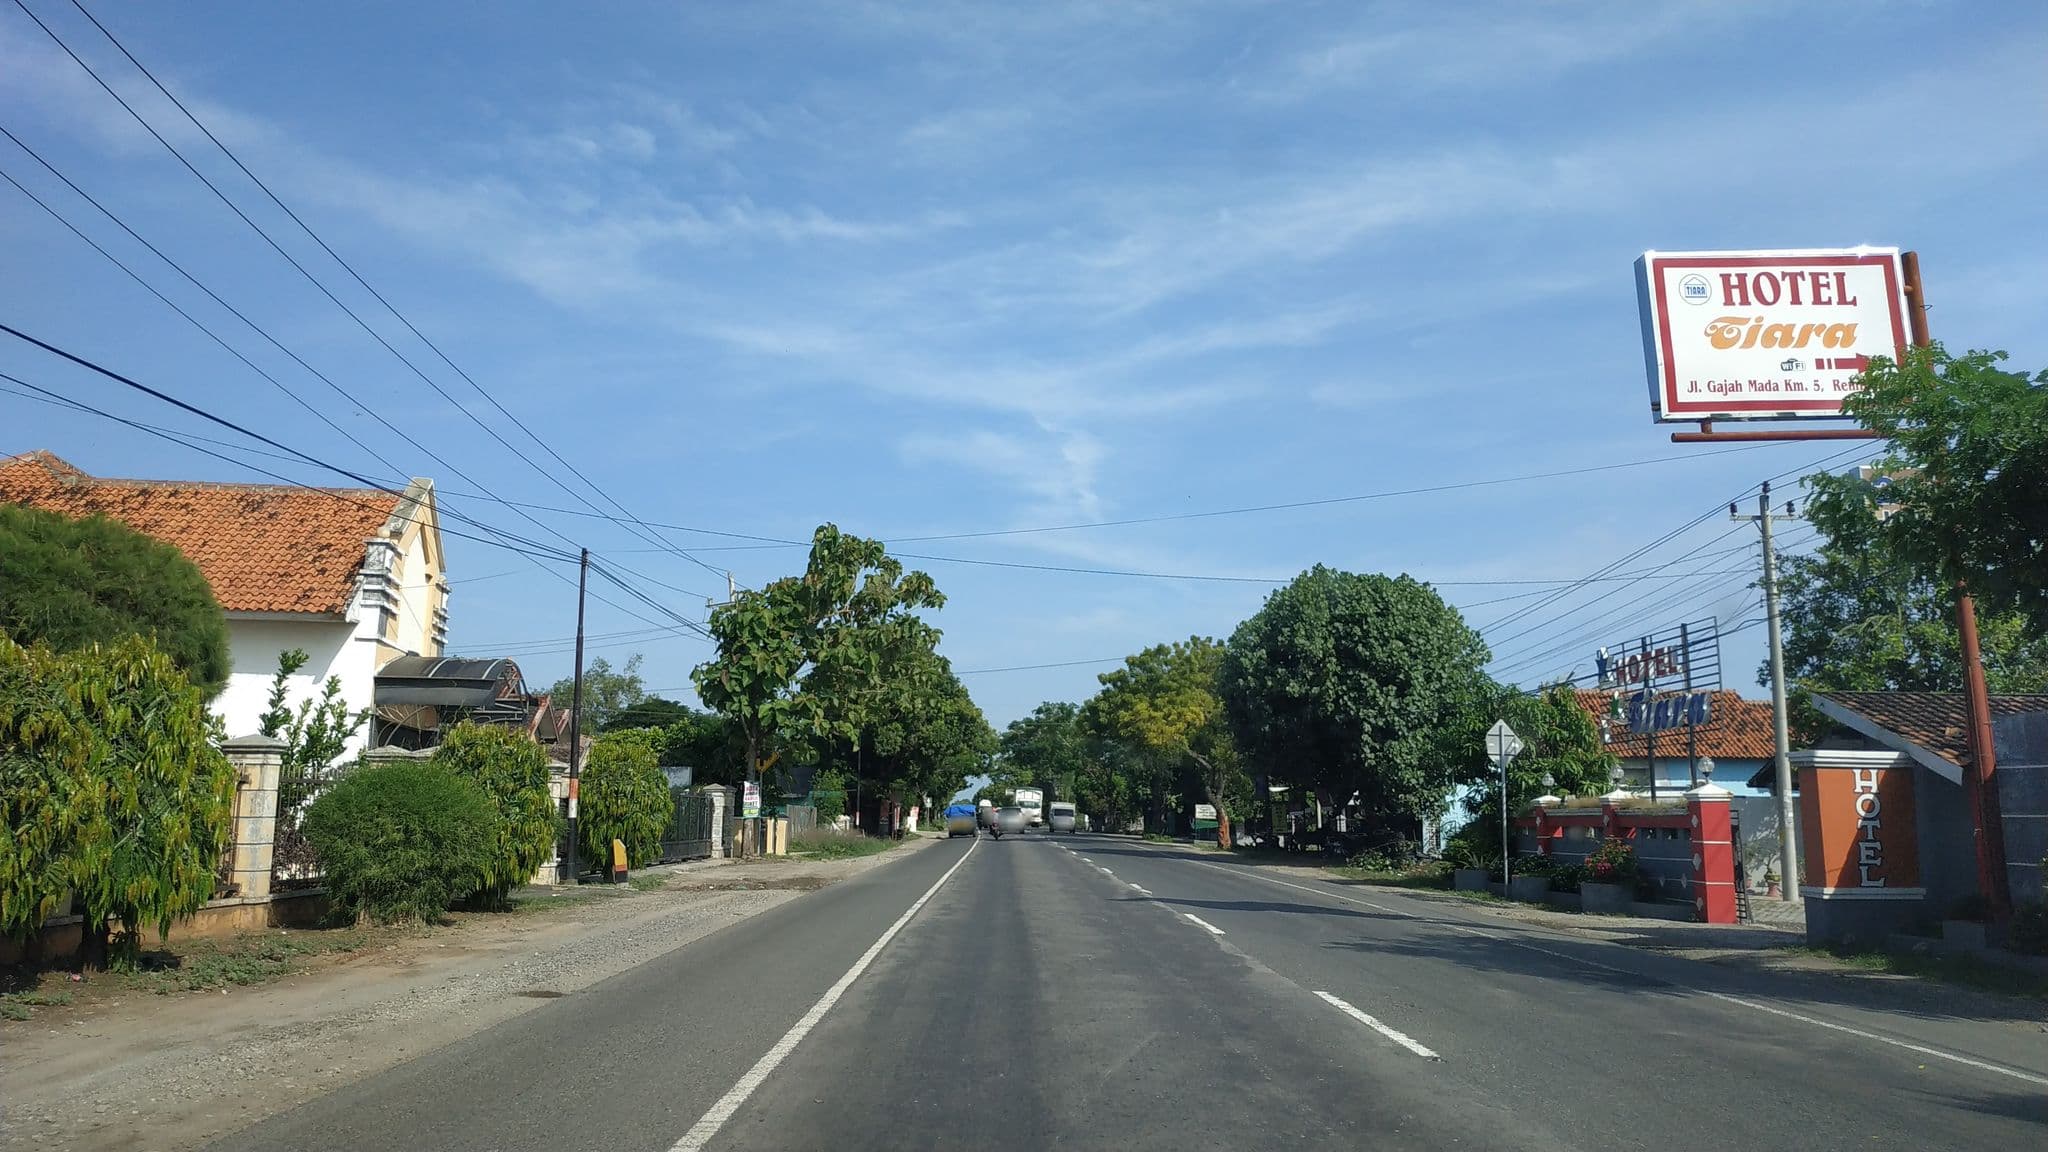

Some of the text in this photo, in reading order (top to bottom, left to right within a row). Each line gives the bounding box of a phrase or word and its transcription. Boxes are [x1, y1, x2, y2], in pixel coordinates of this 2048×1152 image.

[1686, 286, 1706, 296] TIARA
[1719, 271, 1857, 306] HOTEL
[1703, 316, 1858, 350] Tiara
[1687, 380, 1702, 393] Jl.
[1707, 379, 1743, 396] Gajah
[1748, 379, 1779, 392] Mada
[1784, 379, 1808, 392] Km.
[1813, 379, 1824, 392] 5,
[1616, 647, 1679, 686] HOTEL
[1852, 769, 1886, 888] HOTEL
